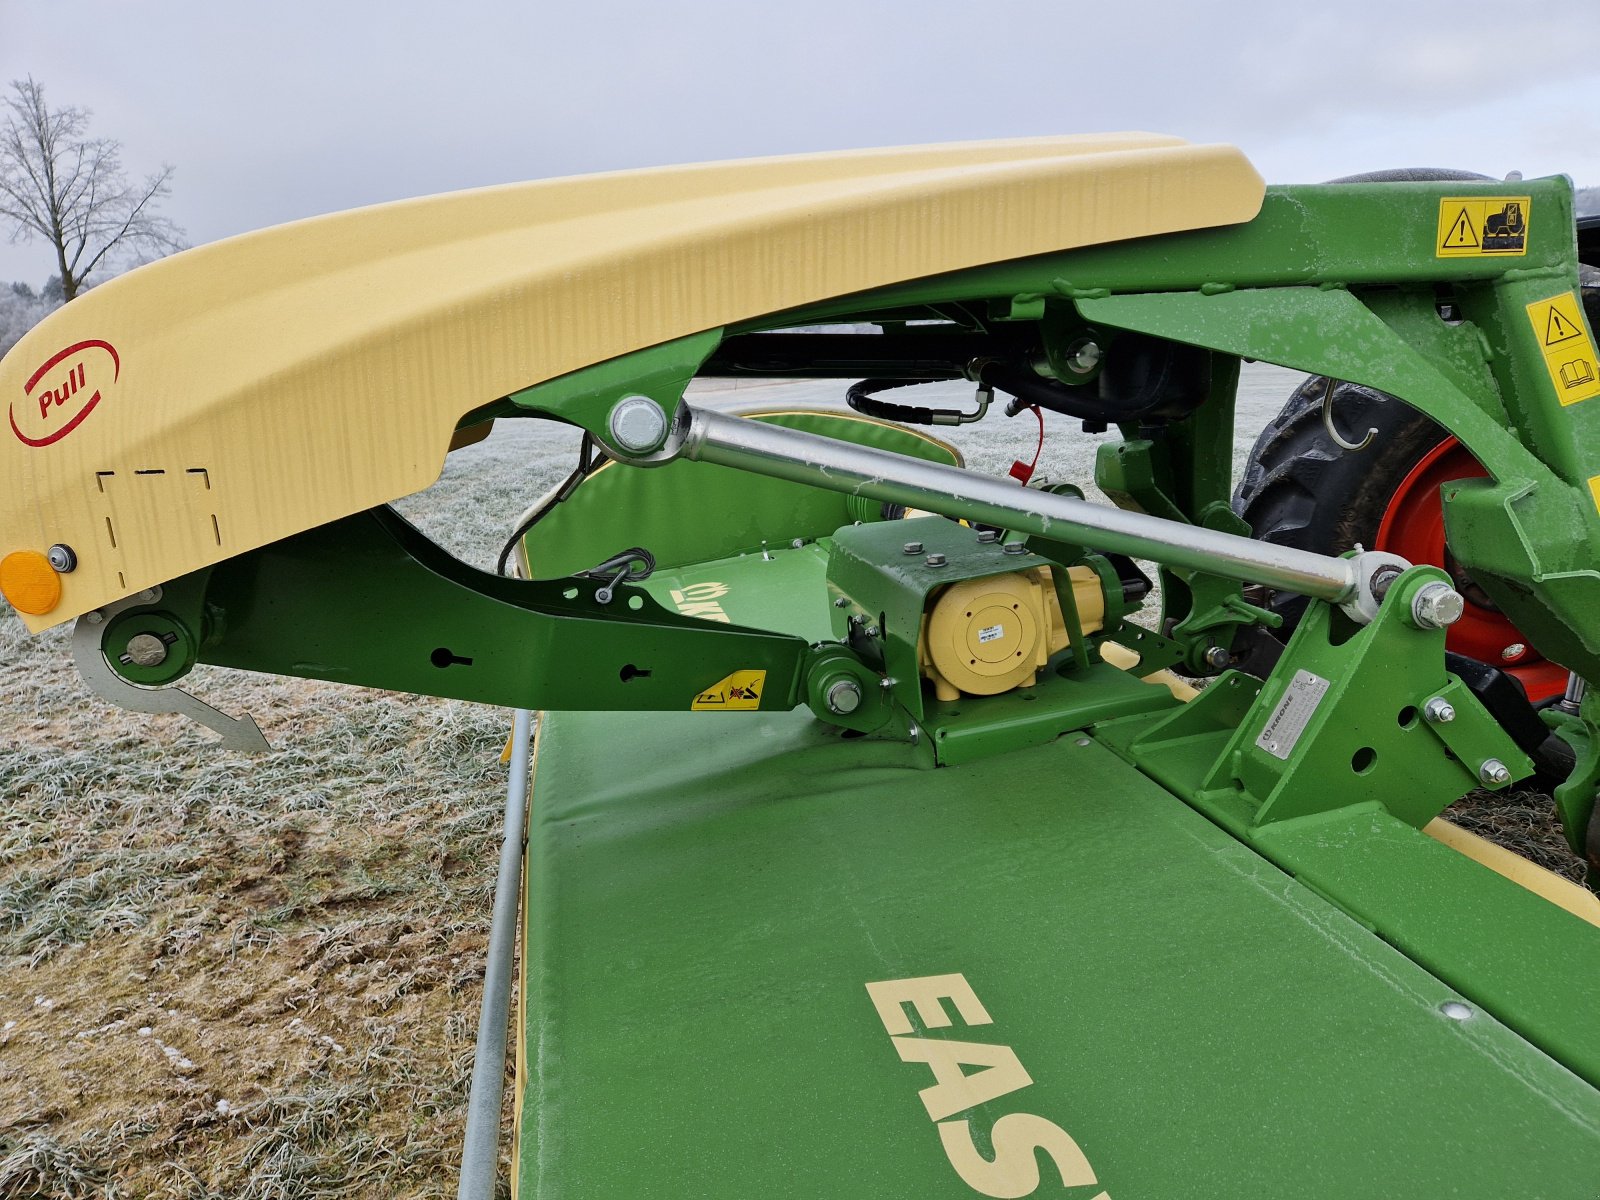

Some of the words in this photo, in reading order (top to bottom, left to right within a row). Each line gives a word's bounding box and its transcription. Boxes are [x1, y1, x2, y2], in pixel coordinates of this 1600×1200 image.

[38, 363, 85, 419] Pull
[1271, 694, 1294, 730] KRONE
[865, 972, 1111, 1200] EAS
